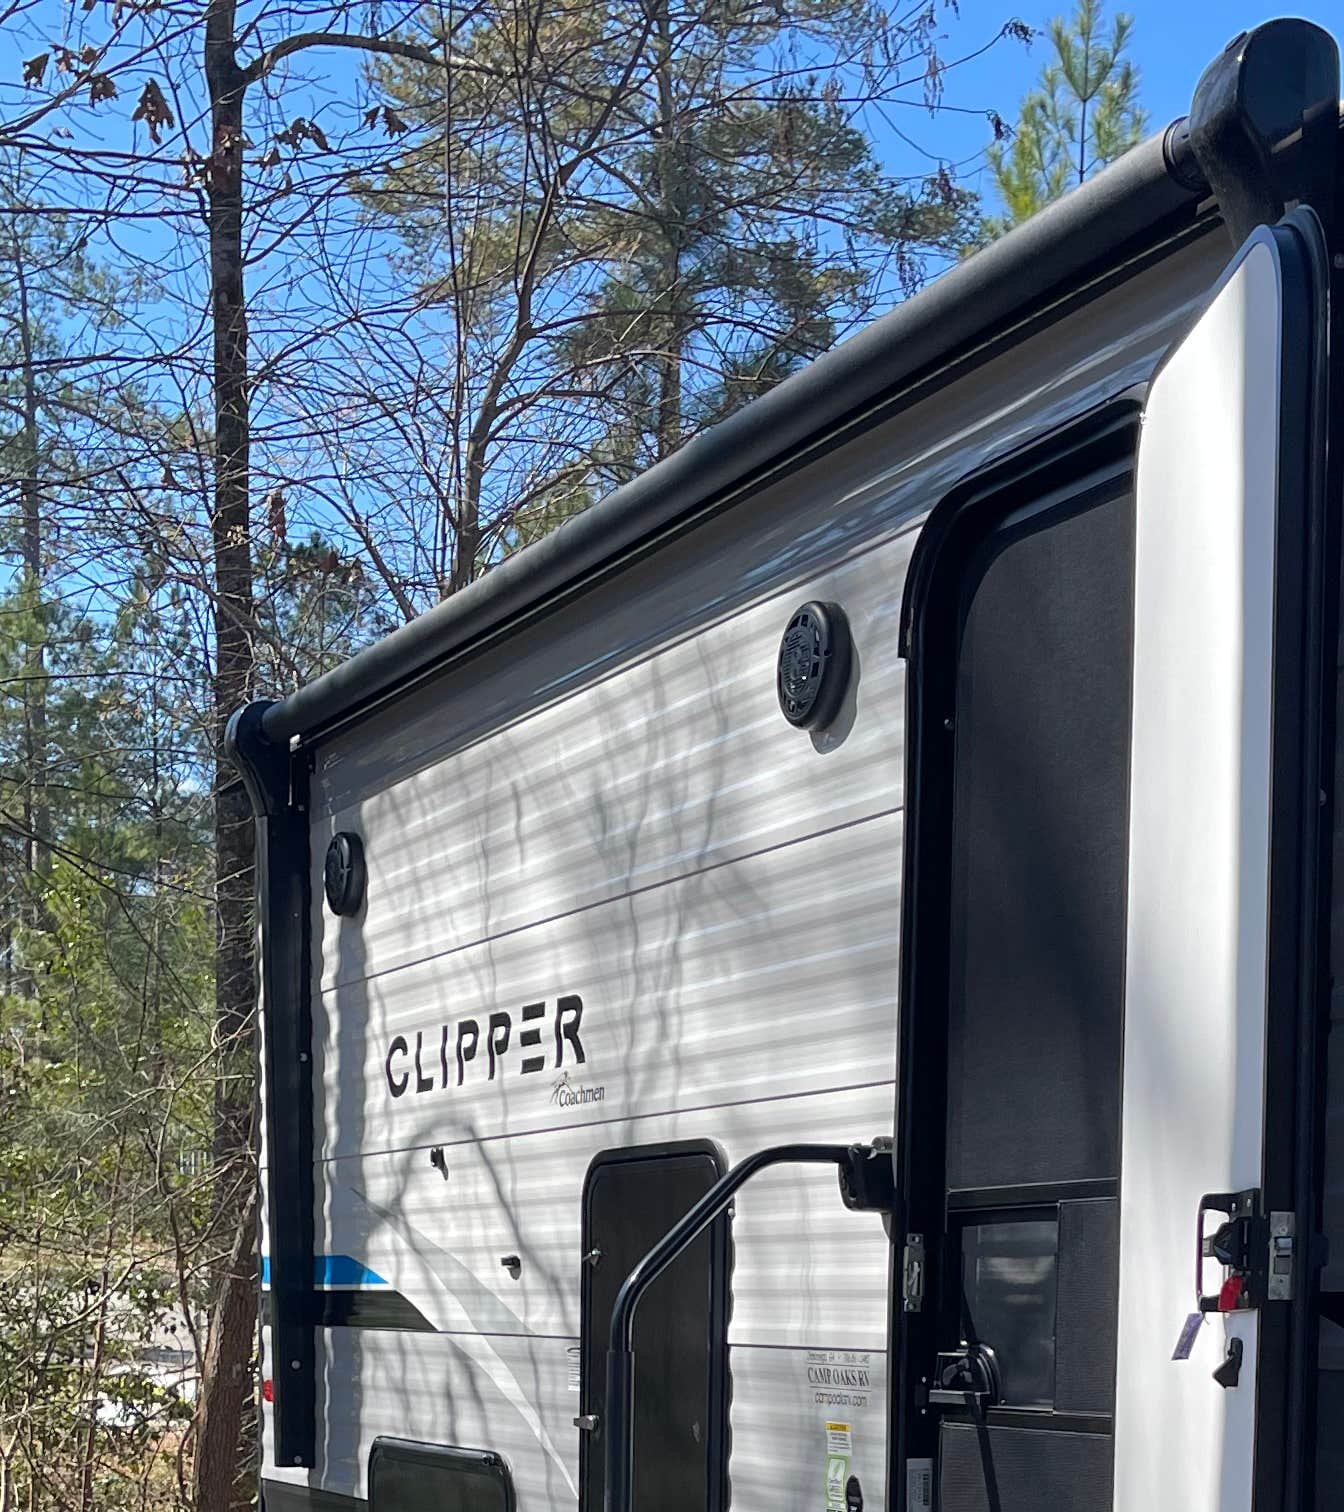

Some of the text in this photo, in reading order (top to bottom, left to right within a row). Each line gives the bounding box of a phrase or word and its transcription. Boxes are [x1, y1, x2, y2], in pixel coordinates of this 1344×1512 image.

[385, 994, 586, 1098] CLIPPER
[558, 1085, 605, 1108] Coachmen
[807, 1367, 831, 1385] CAMP
[833, 1368, 857, 1386] OAKS
